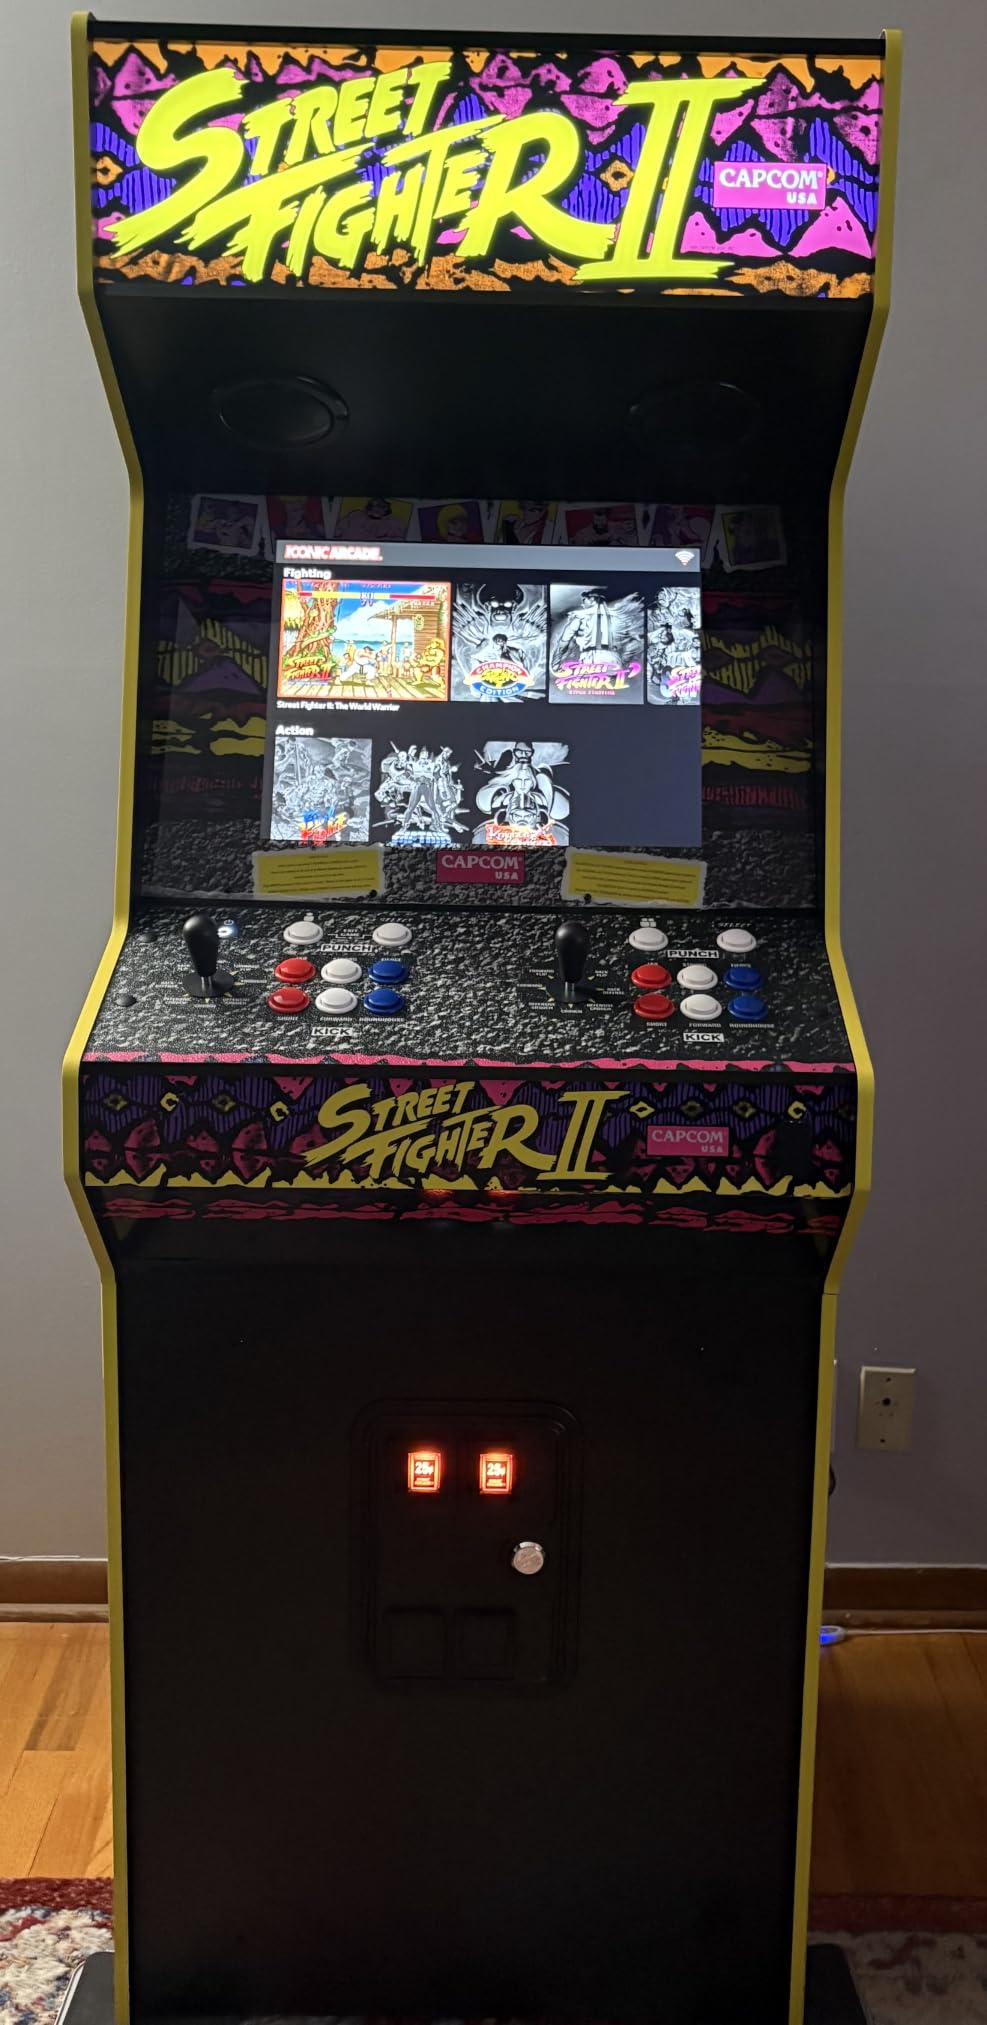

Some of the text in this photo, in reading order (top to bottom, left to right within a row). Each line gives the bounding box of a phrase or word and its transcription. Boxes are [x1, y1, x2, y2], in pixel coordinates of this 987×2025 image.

[111, 62, 453, 259] STREET
[174, 77, 766, 283] FIGHTER II
[719, 168, 819, 189] CAPCOM
[786, 191, 818, 205] USA
[283, 567, 332, 580] Fighting
[475, 661, 523, 674] CHAMPION
[551, 661, 610, 677] STREET
[555, 673, 615, 691] FIGHTER
[480, 686, 520, 695] EDITION
[276, 701, 300, 709] Street
[300, 701, 327, 711] Fighter
[335, 702, 349, 710] The
[349, 703, 372, 711] World
[372, 704, 400, 712] Warrior
[275, 725, 314, 736] Action
[441, 855, 519, 869] CAPCOM
[494, 871, 519, 880] USA
[321, 944, 372, 952] PUNCH
[668, 950, 718, 958] PUNCH
[313, 1027, 350, 1036] KICK
[685, 1033, 721, 1041] KICK
[300, 1081, 475, 1168] STREET
[330, 1090, 632, 1181] FIGHTER II
[651, 1129, 724, 1143] CAPCOM
[701, 1145, 723, 1153] USA
